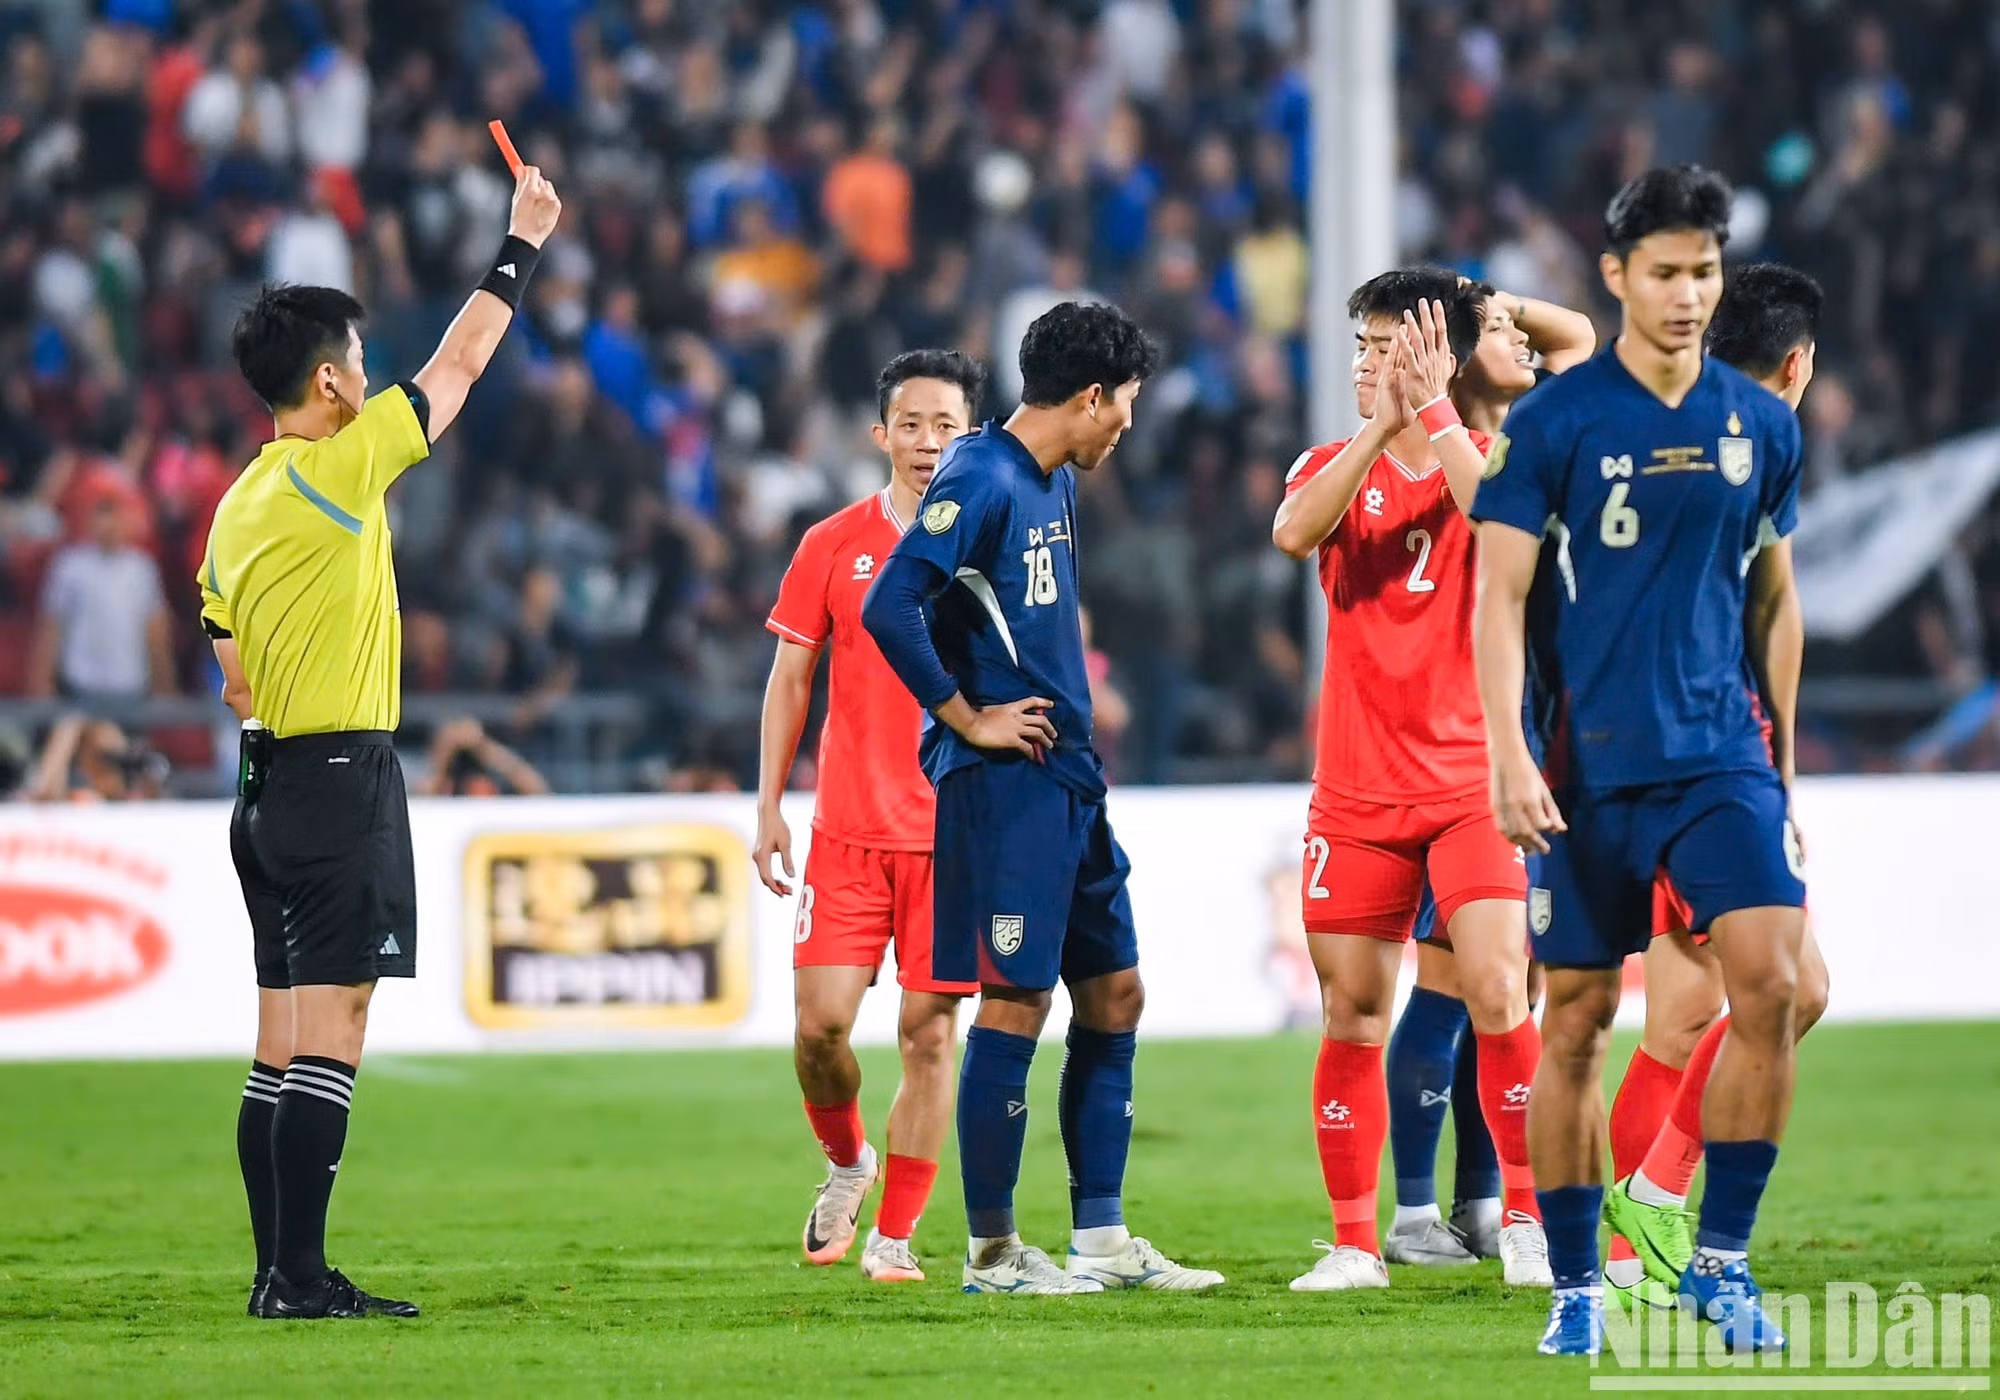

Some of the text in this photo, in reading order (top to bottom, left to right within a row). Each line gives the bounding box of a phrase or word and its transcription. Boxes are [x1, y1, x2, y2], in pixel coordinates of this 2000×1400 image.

[1601, 482, 1640, 548] 6
[1023, 547, 1058, 607] 18
[1406, 529, 1436, 592] 2
[1308, 835, 1330, 898] 2
[507, 950, 705, 1004] IPPIN
